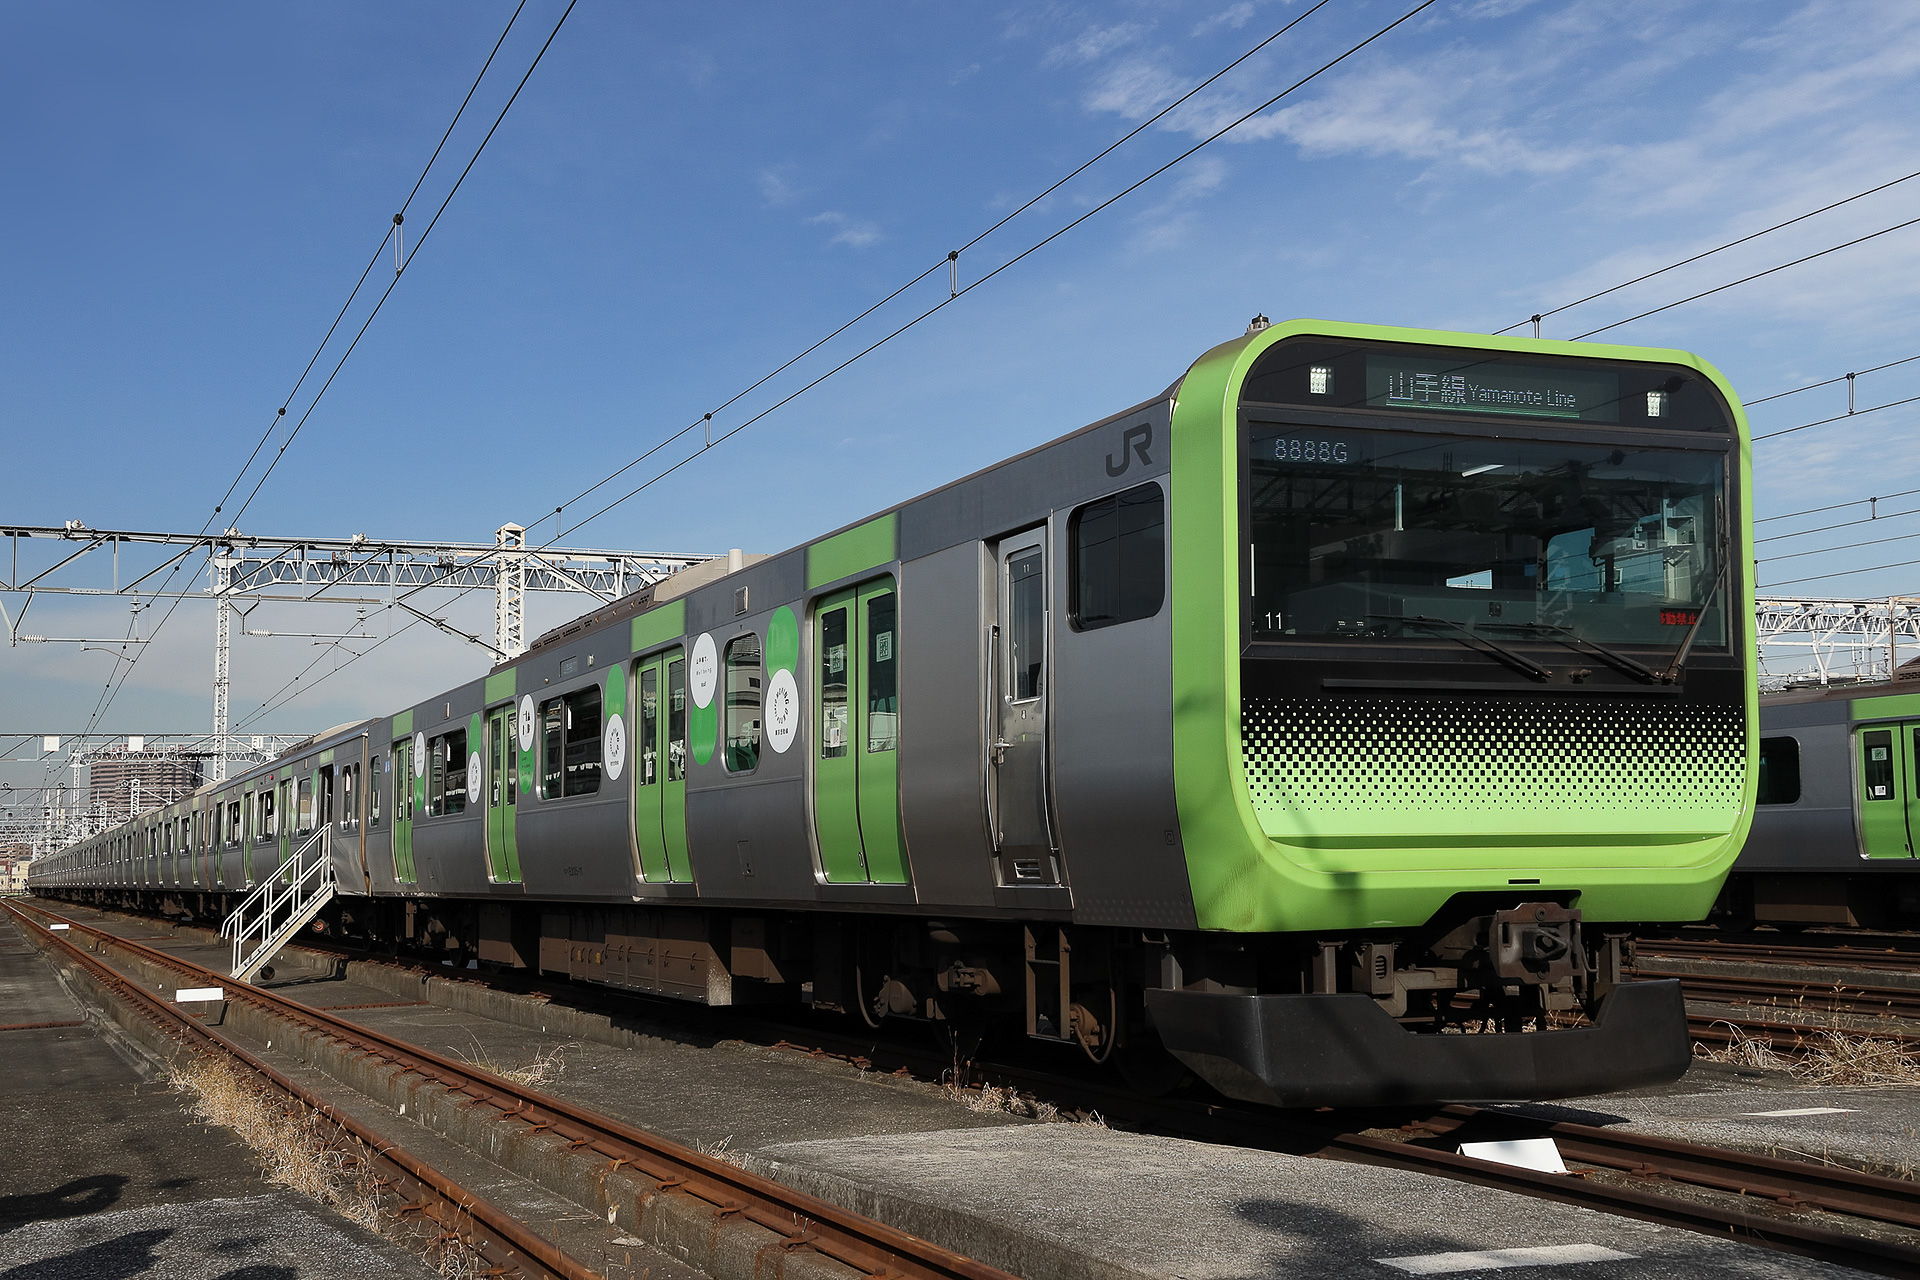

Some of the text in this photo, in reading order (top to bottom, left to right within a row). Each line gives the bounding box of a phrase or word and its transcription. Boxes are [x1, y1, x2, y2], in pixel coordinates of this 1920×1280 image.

[1389, 371, 1467, 404] 山手線
[1468, 383, 1576, 408] Yamanote Line
[1105, 422, 1153, 478] JR
[1274, 438, 1347, 463] 8888G
[1265, 611, 1282, 630] 11
